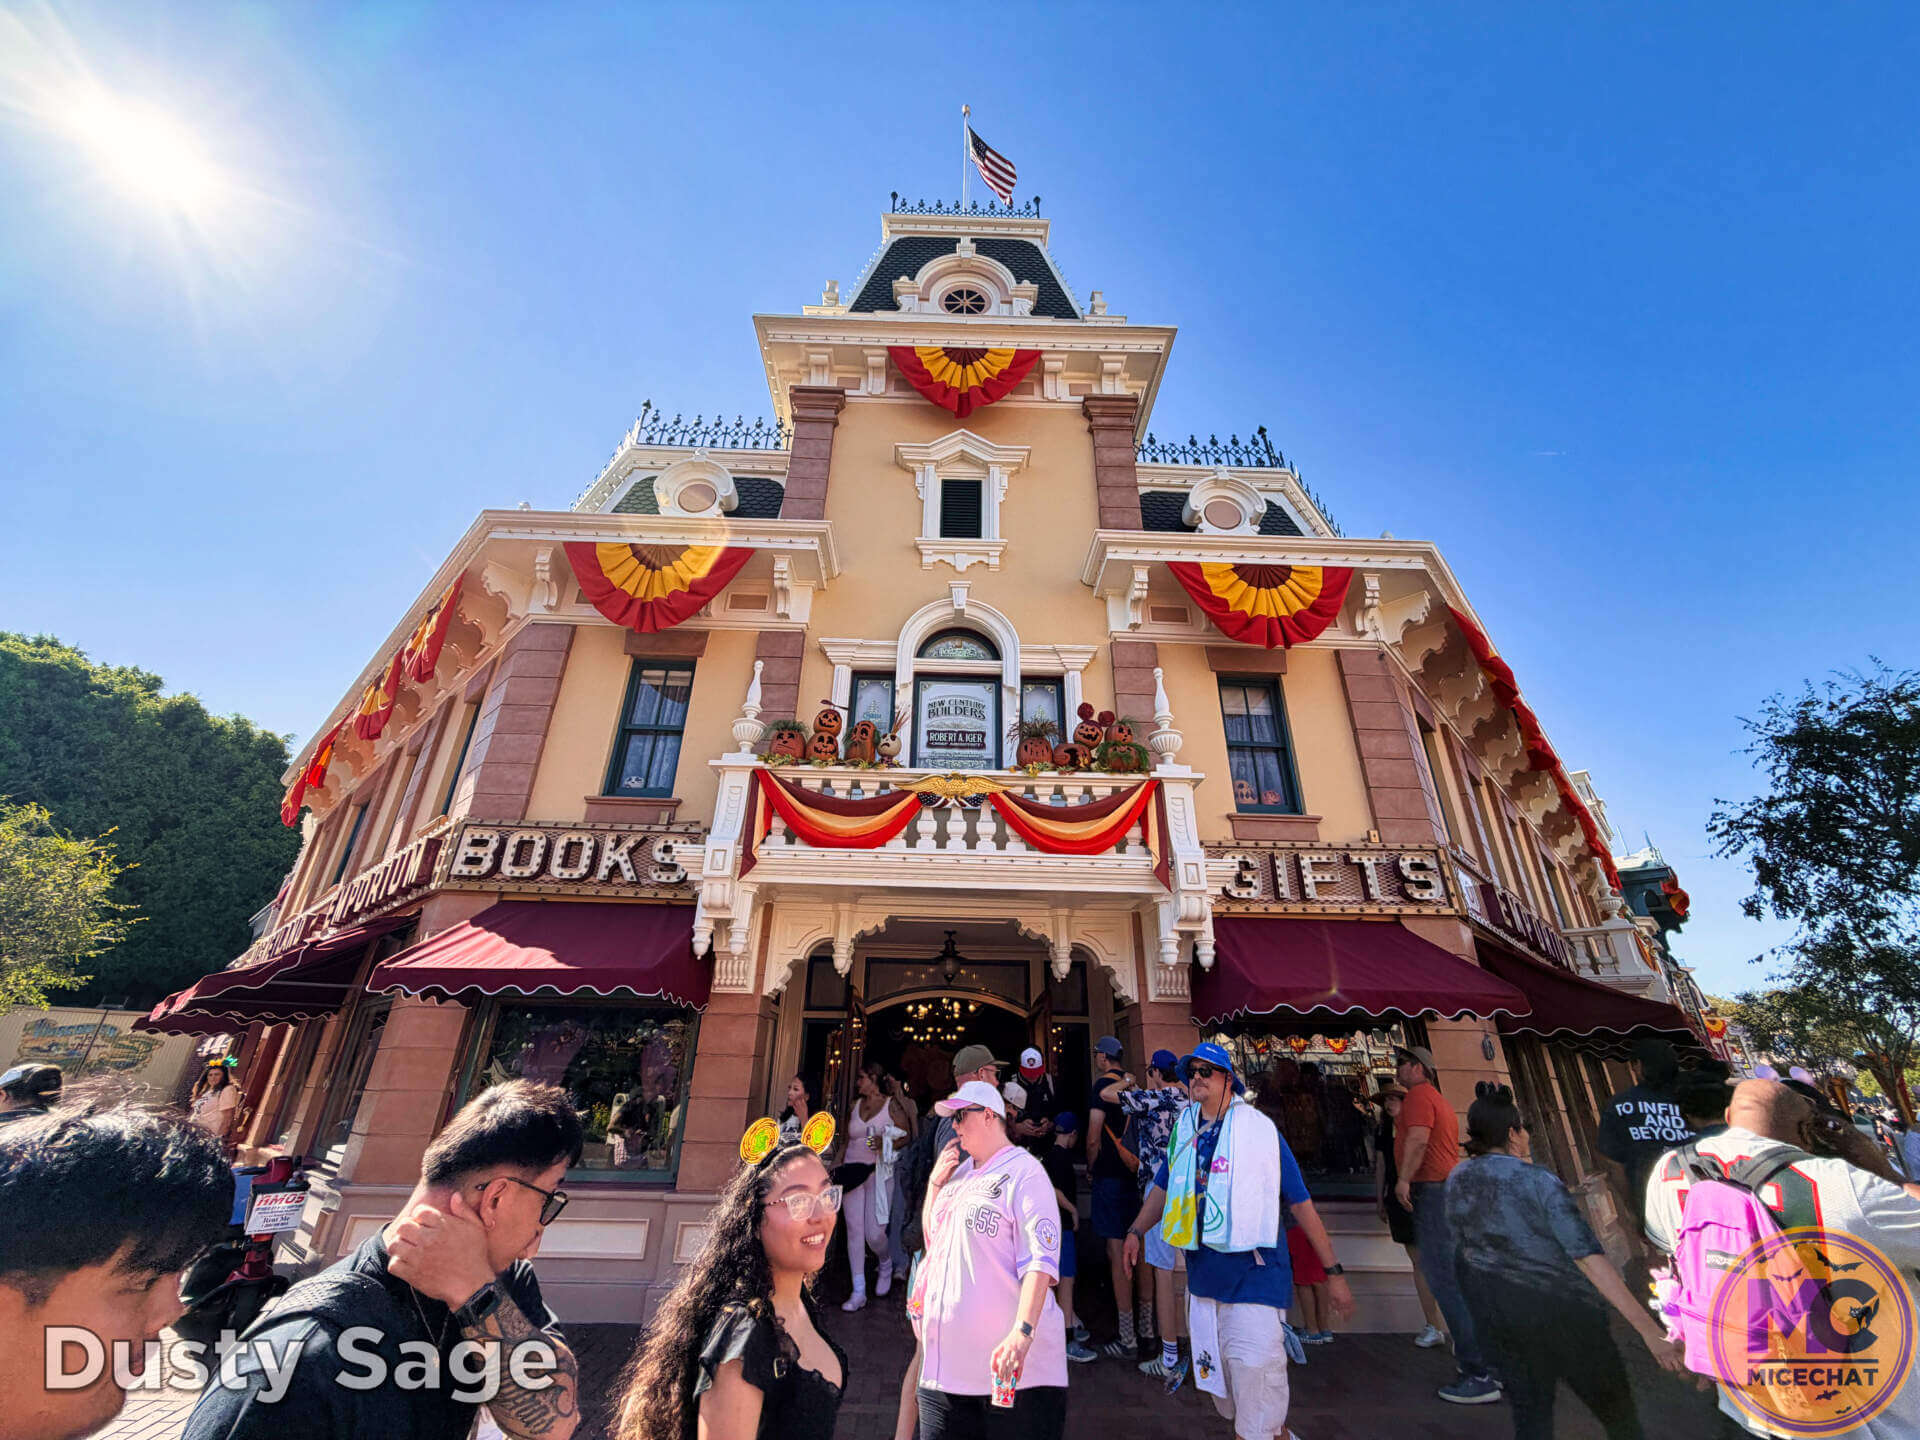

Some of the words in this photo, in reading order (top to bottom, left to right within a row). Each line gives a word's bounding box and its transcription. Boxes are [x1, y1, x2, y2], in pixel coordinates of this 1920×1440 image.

[928, 700, 946, 709] NEW
[948, 699, 986, 710] CENTURY
[928, 706, 986, 720] BUILDERS
[929, 732, 956, 743] ROBERT
[965, 733, 983, 743] IGER
[450, 829, 689, 884] BOOKS
[1222, 850, 1441, 901] GIFTS
[1615, 1102, 1634, 1117] TO
[1644, 1114, 1686, 1129] AND
[1628, 1126, 1697, 1142] BEYON
